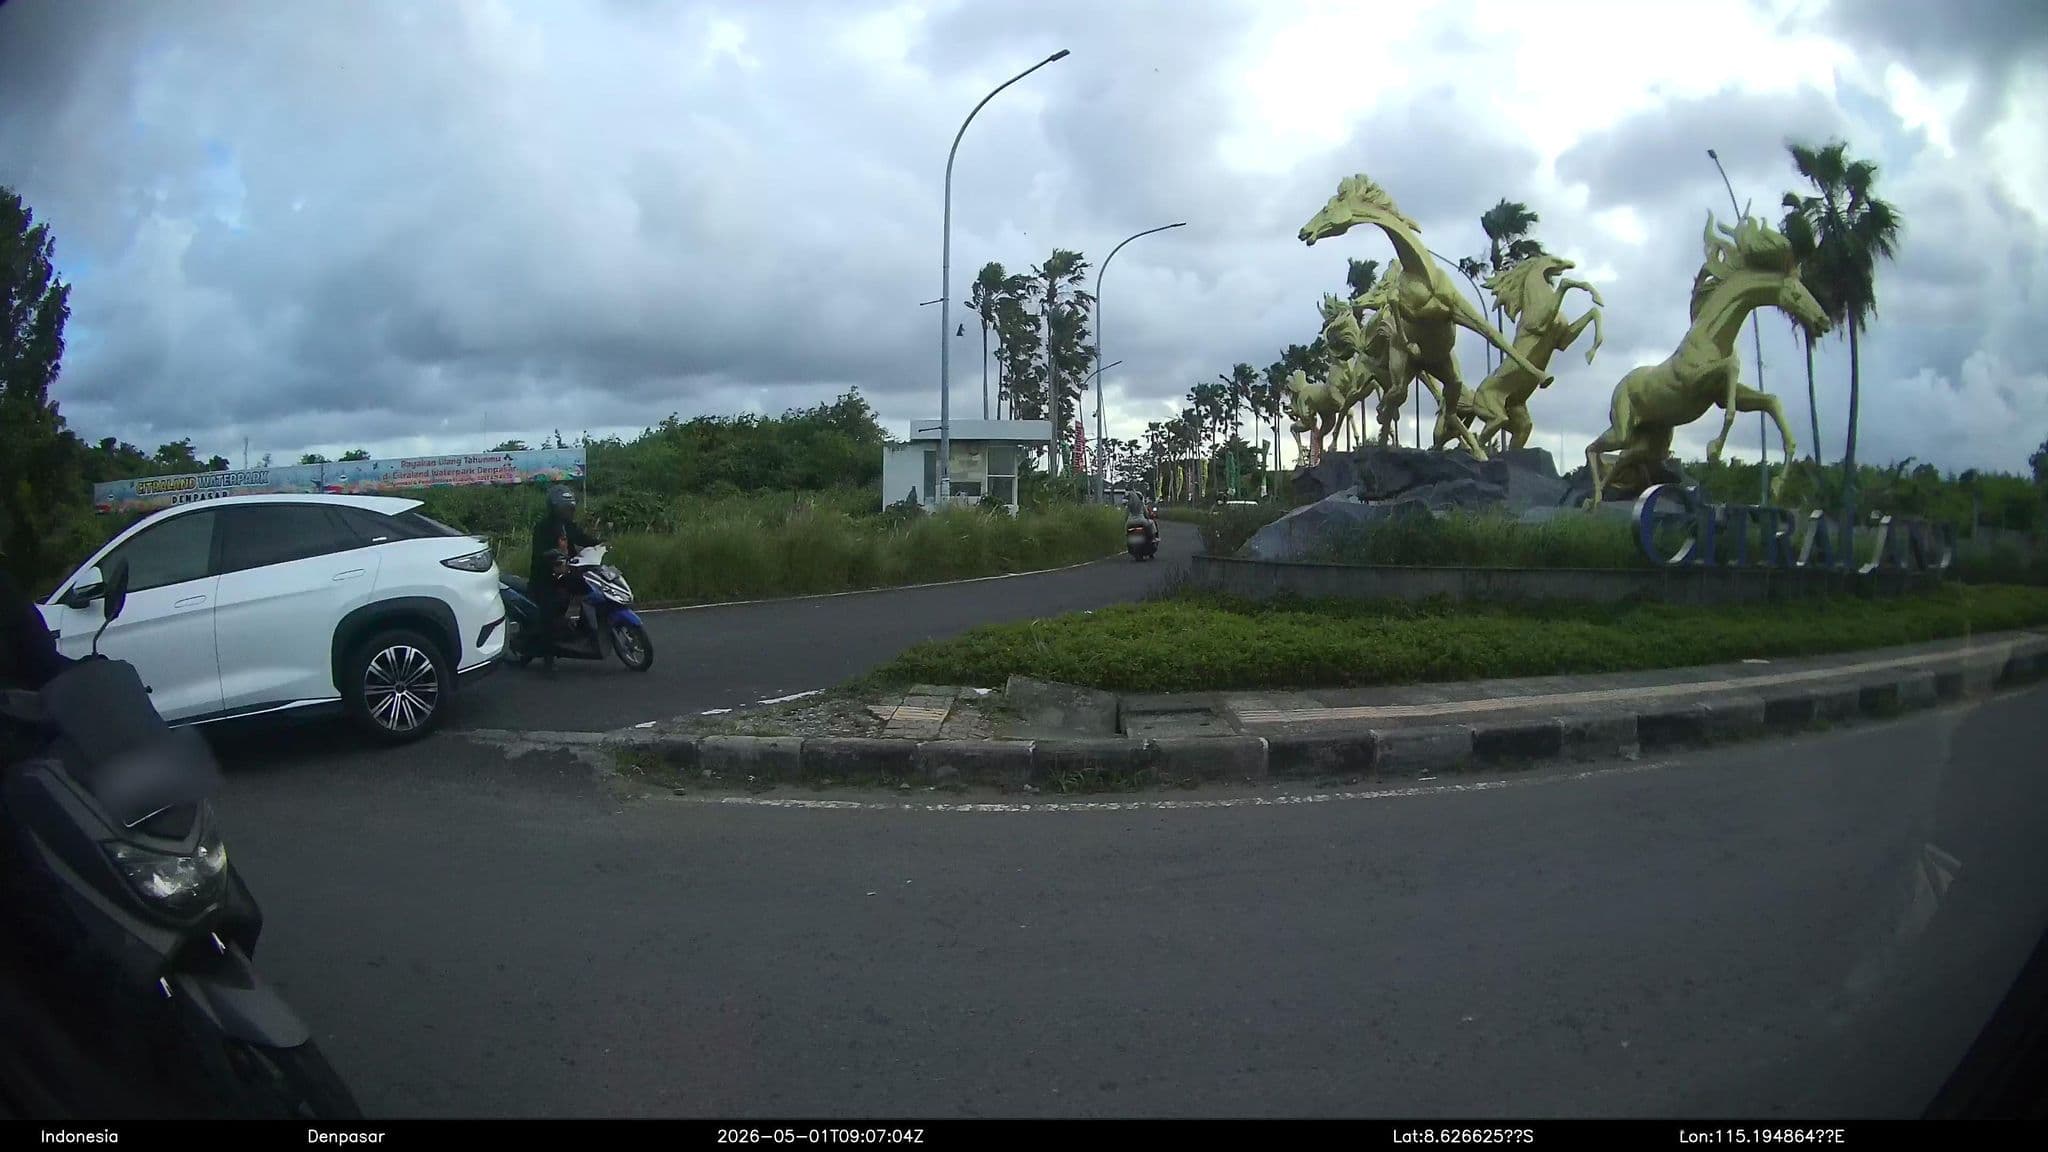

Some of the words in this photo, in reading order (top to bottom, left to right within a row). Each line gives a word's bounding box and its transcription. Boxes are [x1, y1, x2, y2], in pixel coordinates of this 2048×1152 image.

[136, 477, 196, 496] CITRALAND
[198, 471, 269, 489] WATERPARK
[172, 490, 228, 504] DENPASAR
